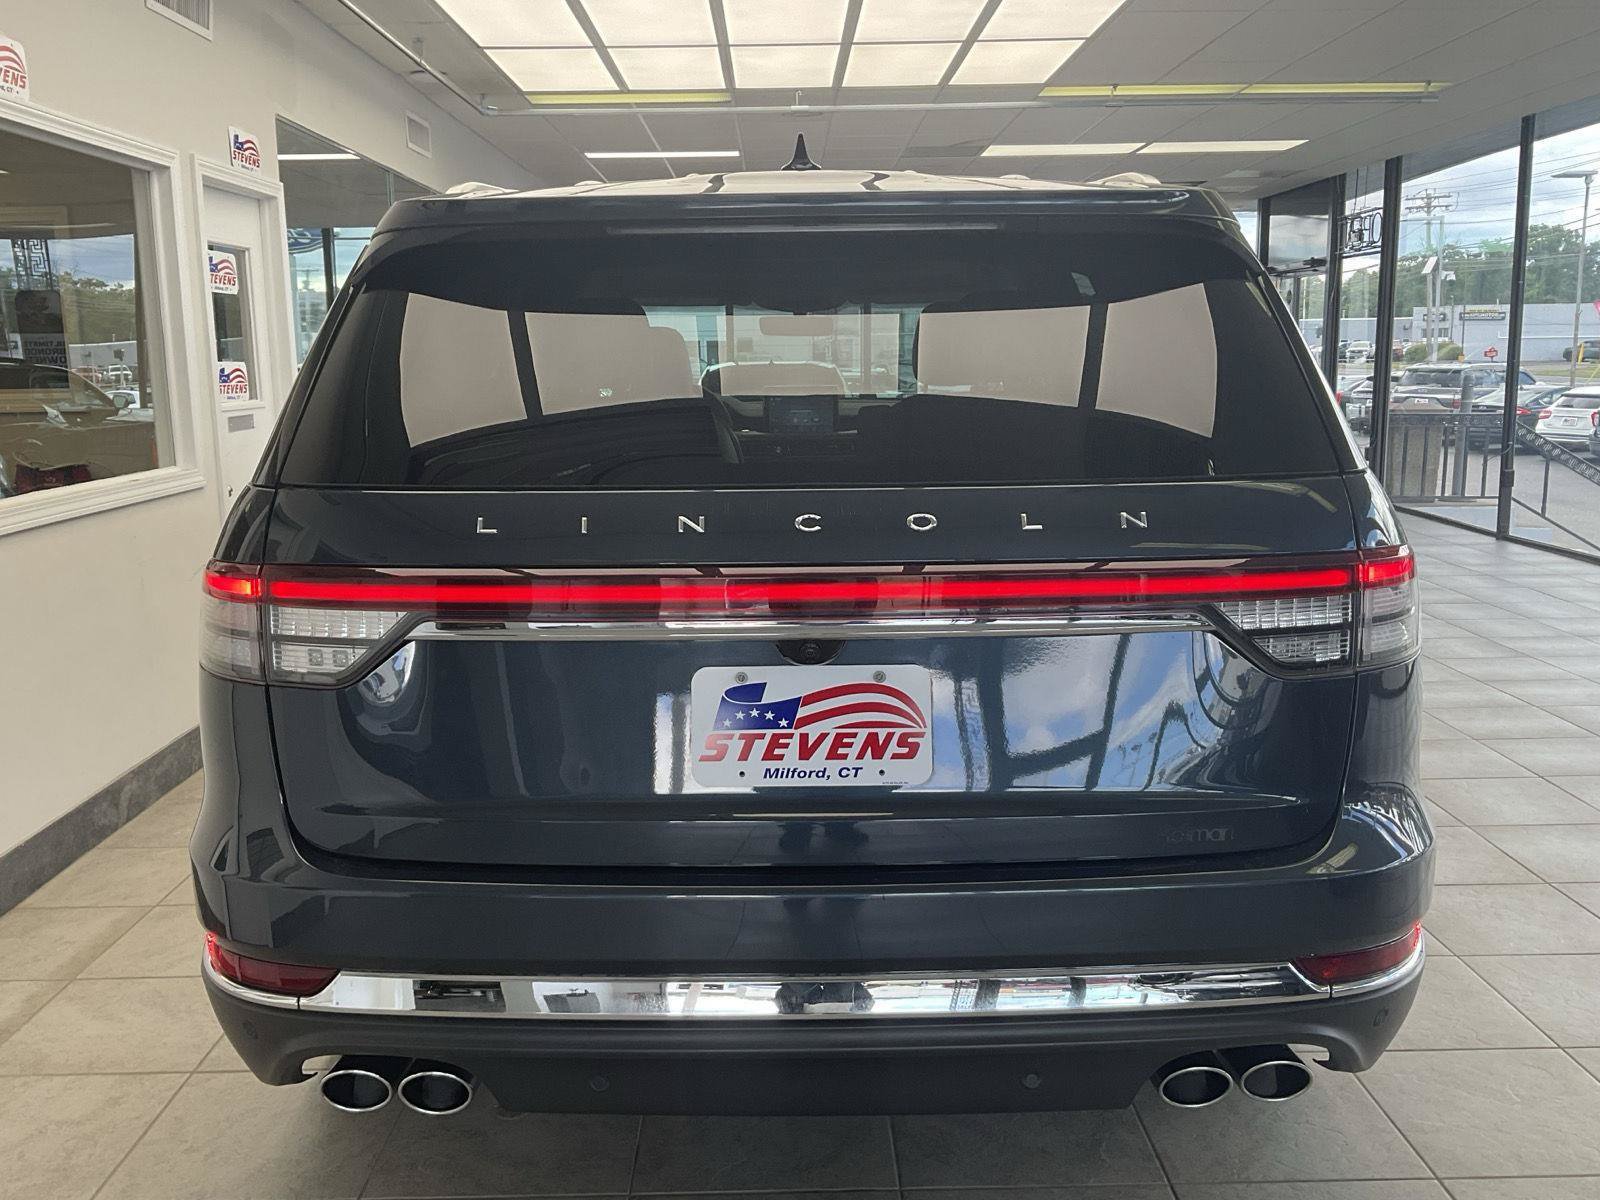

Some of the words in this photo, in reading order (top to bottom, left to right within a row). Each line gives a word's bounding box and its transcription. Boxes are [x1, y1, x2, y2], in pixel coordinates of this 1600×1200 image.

[233, 150, 261, 168] STEVENS
[209, 273, 237, 286] TEVENS
[476, 511, 1148, 534] LINCOLN
[698, 731, 926, 762] STEVENS
[763, 767, 831, 780] Milford,
[838, 767, 863, 778] CT
